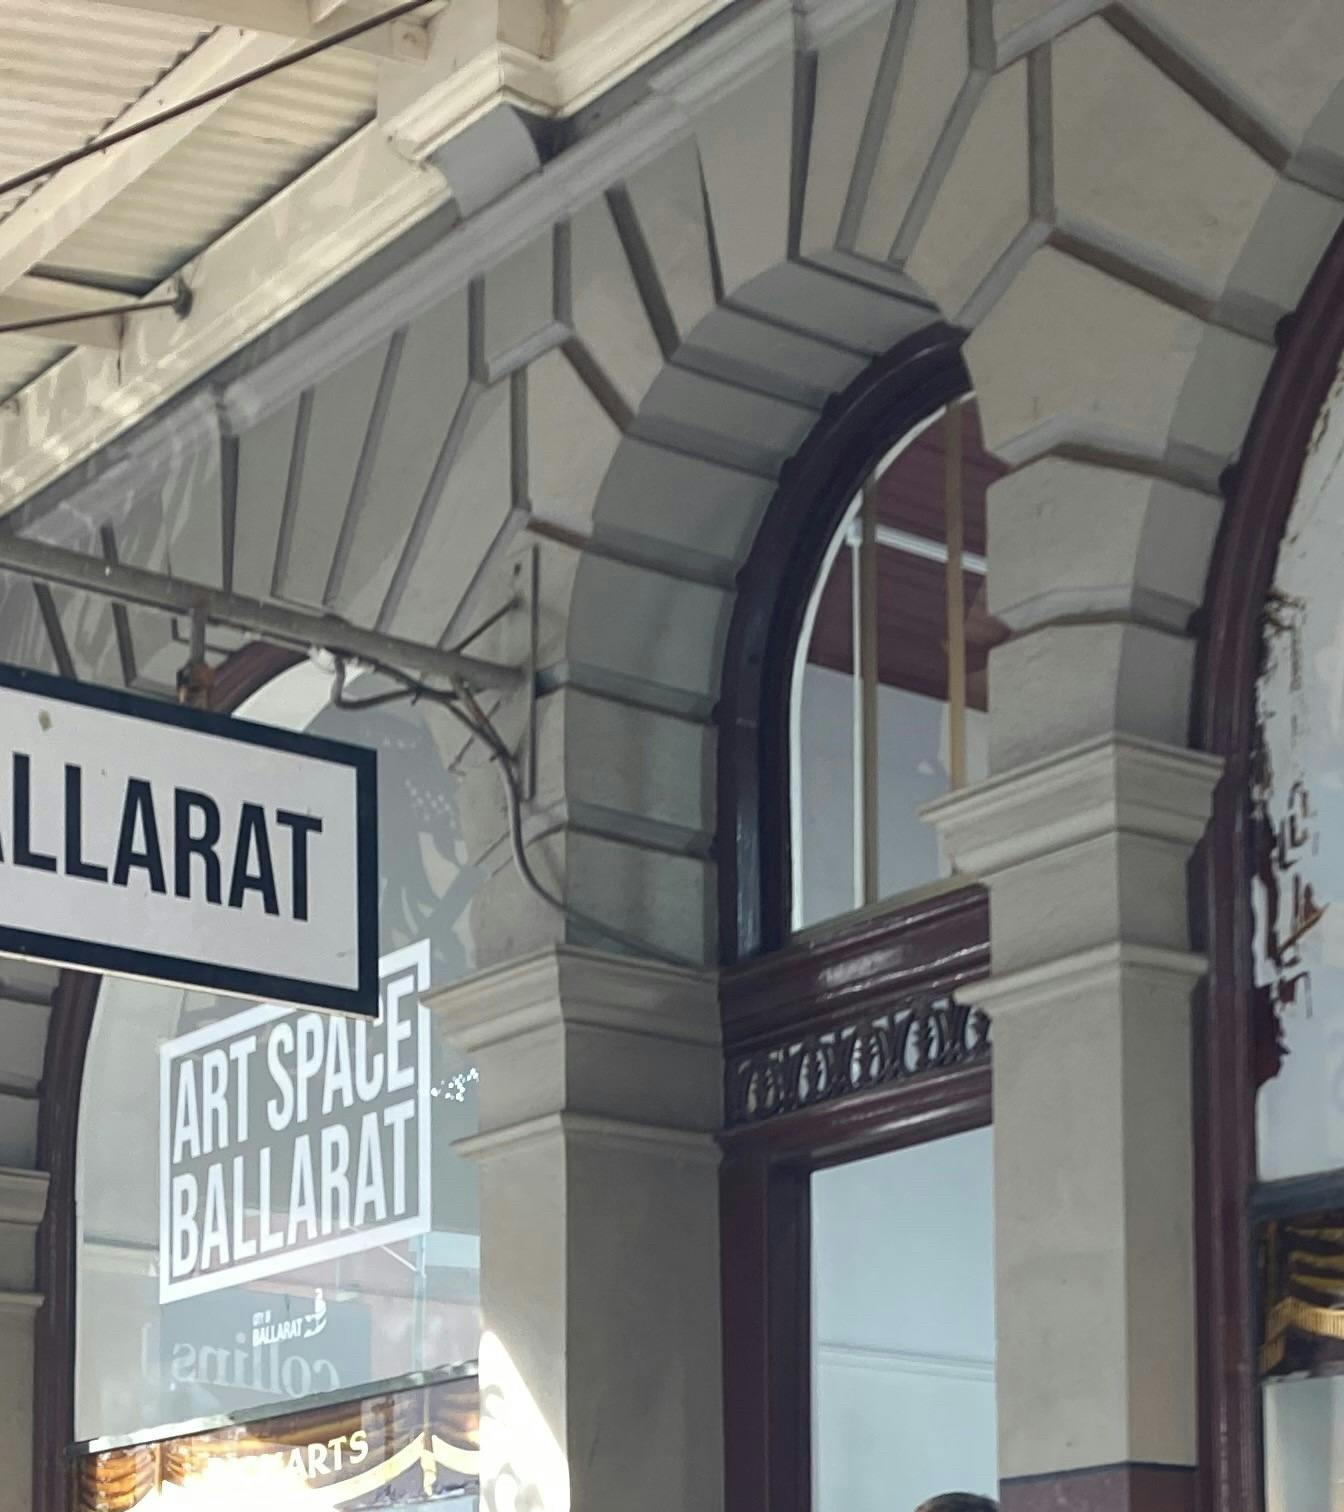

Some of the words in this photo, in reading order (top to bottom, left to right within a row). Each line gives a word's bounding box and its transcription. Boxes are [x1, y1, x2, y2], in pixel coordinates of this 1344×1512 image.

[173, 1032, 256, 1164] ART
[265, 974, 416, 1132] SPACE
[172, 1099, 415, 1279] BALLARAT
